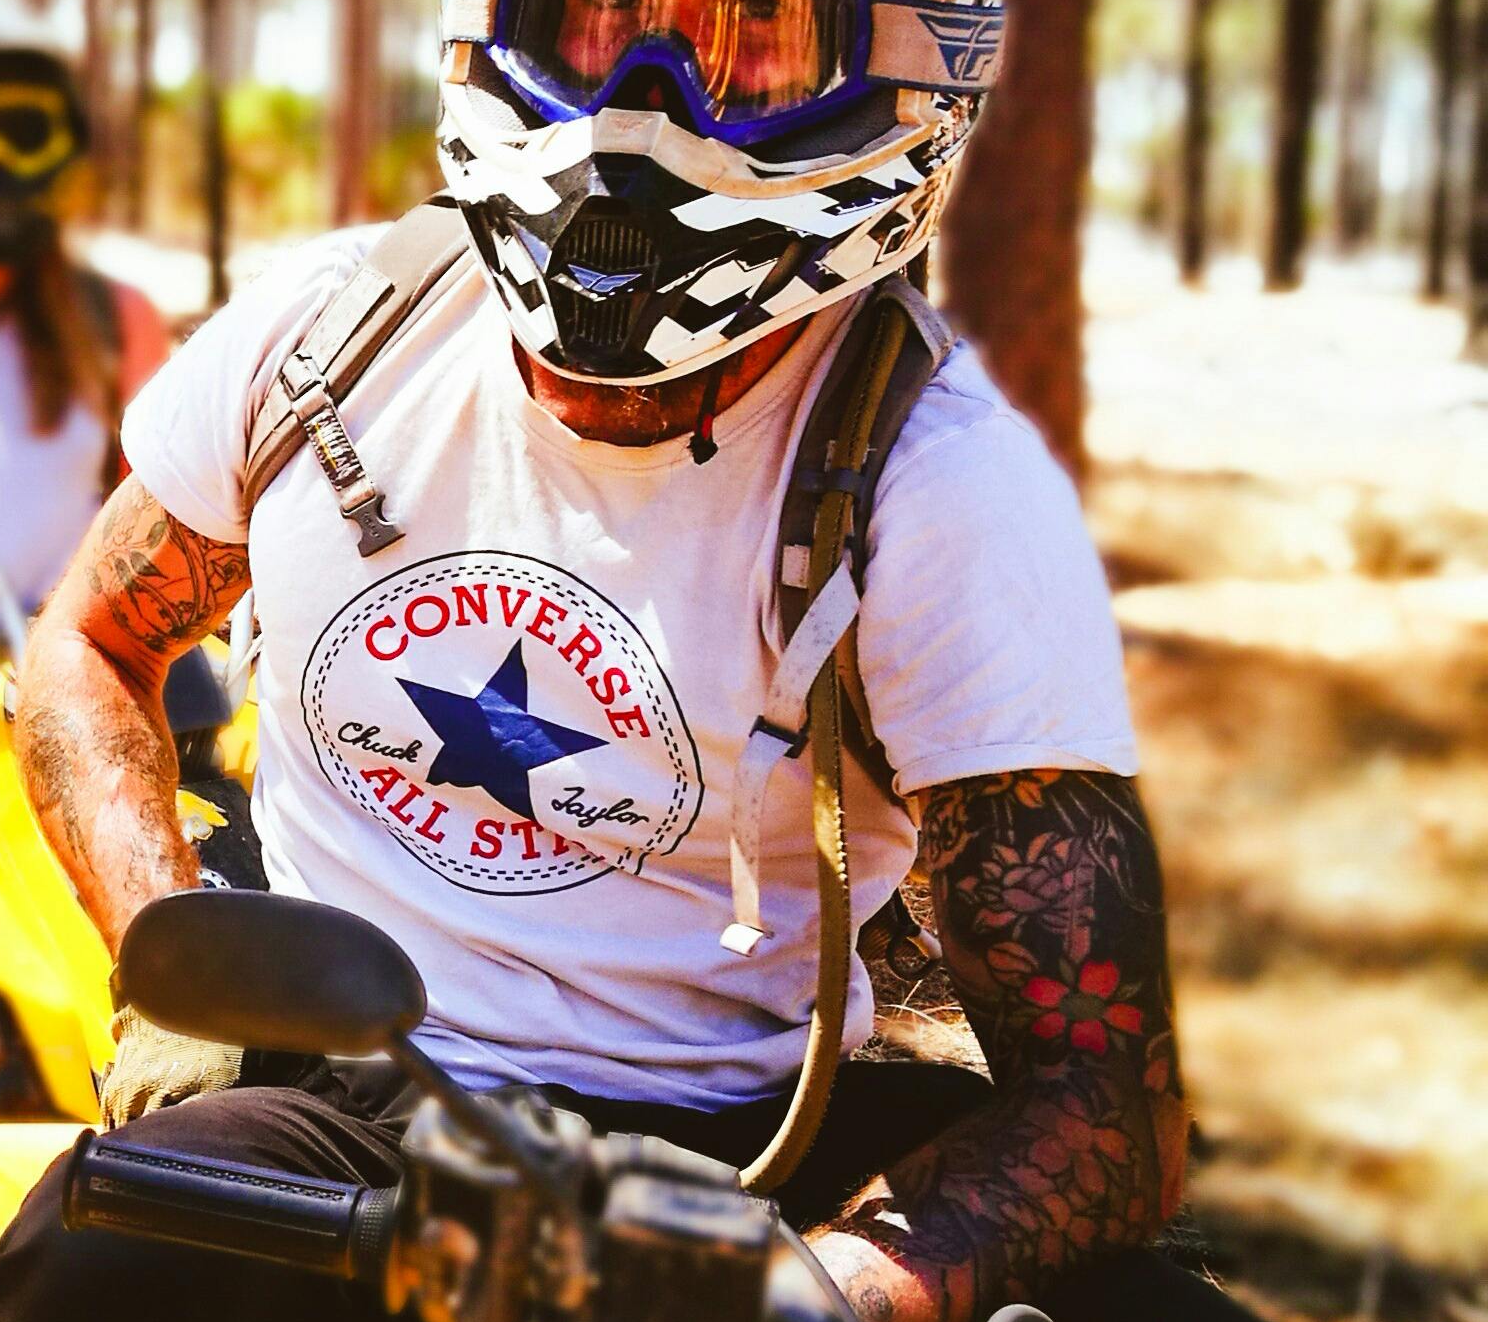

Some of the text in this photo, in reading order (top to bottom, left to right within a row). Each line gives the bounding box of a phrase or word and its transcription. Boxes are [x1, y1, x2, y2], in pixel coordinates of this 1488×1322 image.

[365, 583, 650, 739] CONVERSE
[337, 722, 650, 828] Chuck Taylor
[360, 765, 450, 844] ALL
